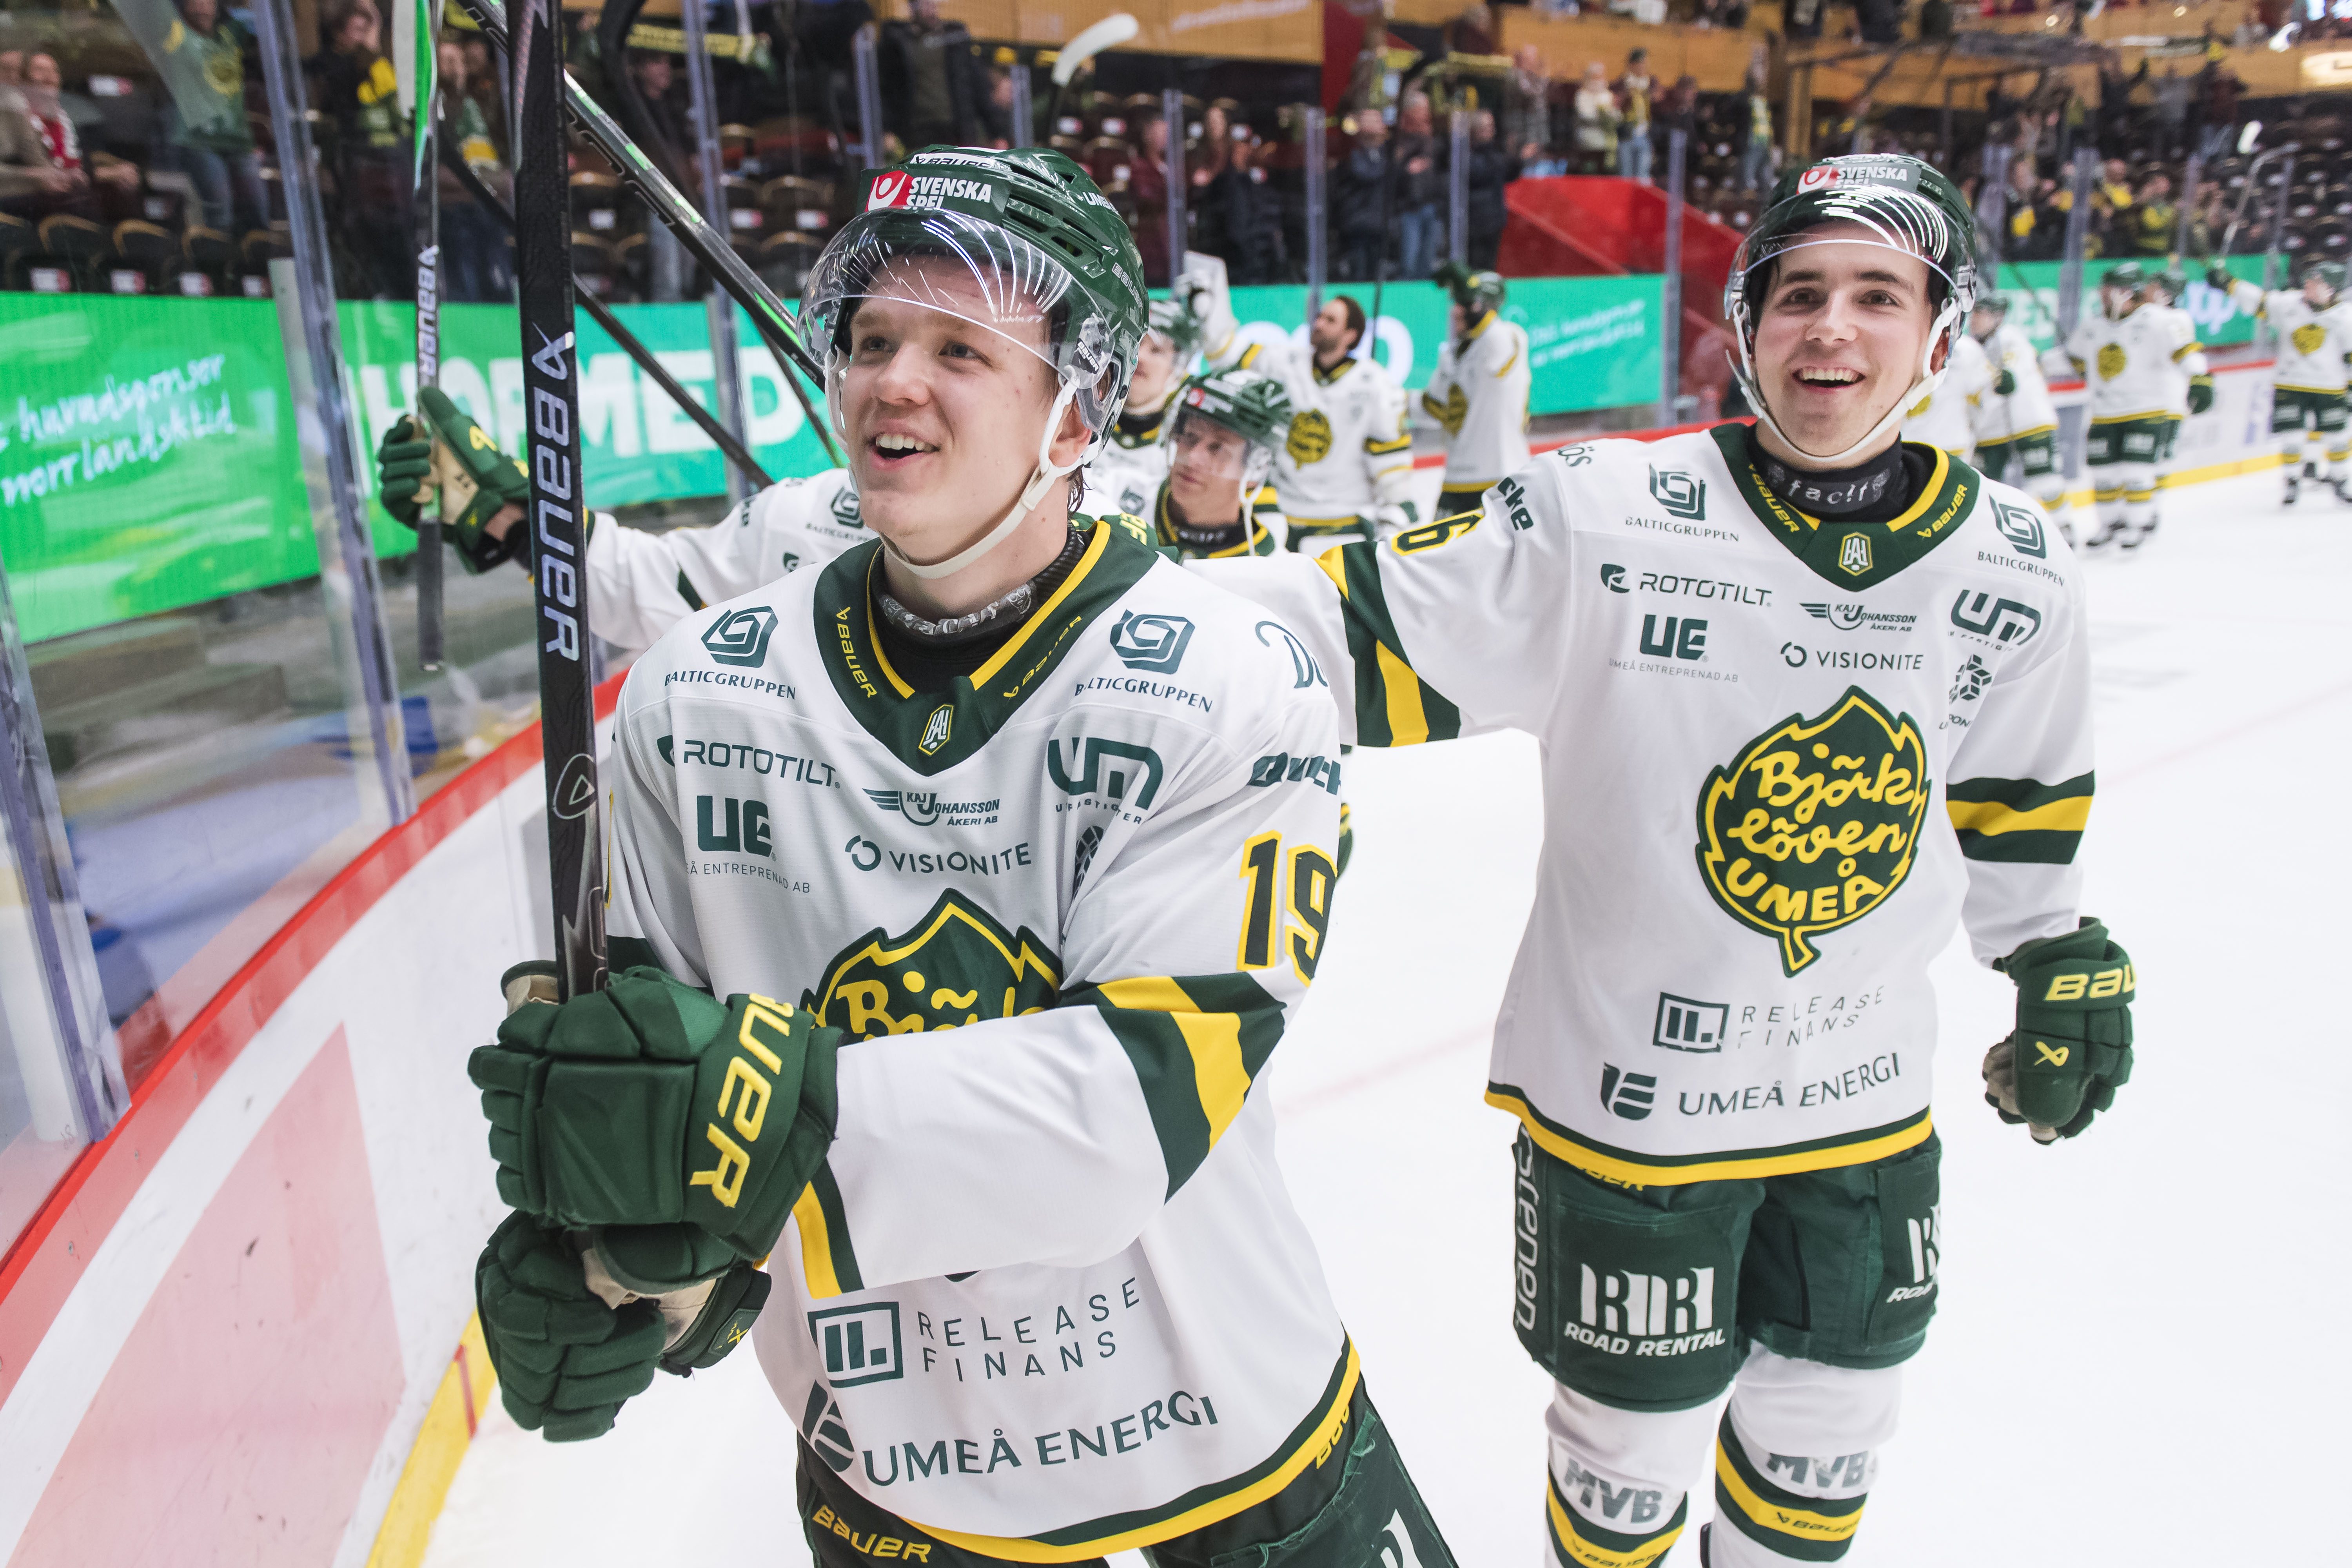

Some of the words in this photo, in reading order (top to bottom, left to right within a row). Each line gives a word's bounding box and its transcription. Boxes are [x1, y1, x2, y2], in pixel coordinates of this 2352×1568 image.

[910, 177, 992, 203] SVENSKA
[1837, 166, 1907, 181] SVENSKA
[533, 386, 580, 662] BAUER
[1931, 483, 1968, 534] BAUER
[1624, 515, 1740, 543] BALTICGRUPPEN
[1639, 572, 1773, 606] ROTOTILT
[1977, 551, 2065, 588] BALTICGRUPPEN
[1835, 604, 1853, 613] KAJ
[837, 622, 878, 698] BAUER
[1021, 615, 1083, 686] BAUER
[1817, 650, 1924, 670] VISIONITE
[664, 670, 796, 700] BALTICGRUPPEN
[1639, 662, 1721, 681] ENTREPRENAD
[1724, 673, 1739, 683] AB
[1074, 677, 1213, 713] BLTICGRUPPEN
[683, 739, 836, 787] ROTOTILT
[906, 791, 928, 804] KAJ
[1749, 742, 1915, 824] Björk
[947, 815, 981, 827] ÅKERI
[984, 815, 998, 825] AB
[1726, 808, 1907, 864] löven
[704, 863, 788, 889] ENTREPRENAD
[793, 881, 810, 894] AB
[889, 842, 1032, 876] VISIONITE
[1236, 829, 1338, 987] 19
[1725, 857, 1885, 922] UMEÅ
[1741, 985, 1885, 1025] RELEASE
[1737, 1013, 1860, 1049] FINANS
[1678, 1079, 1784, 1116] UMEÅ
[1799, 1052, 1902, 1107] ENERGI
[917, 1277, 1140, 1347] RELEASE
[924, 1330, 1117, 1383] FINANS
[1563, 1321, 1631, 1356] ROAD
[1635, 1328, 1726, 1357] RENTAL
[862, 1427, 1022, 1487] UMEÅ
[1034, 1390, 1219, 1467] ENERGI
[1766, 1450, 1869, 1489] MVB
[1564, 1457, 1662, 1524] MVB
[812, 1504, 931, 1564] BAUER
